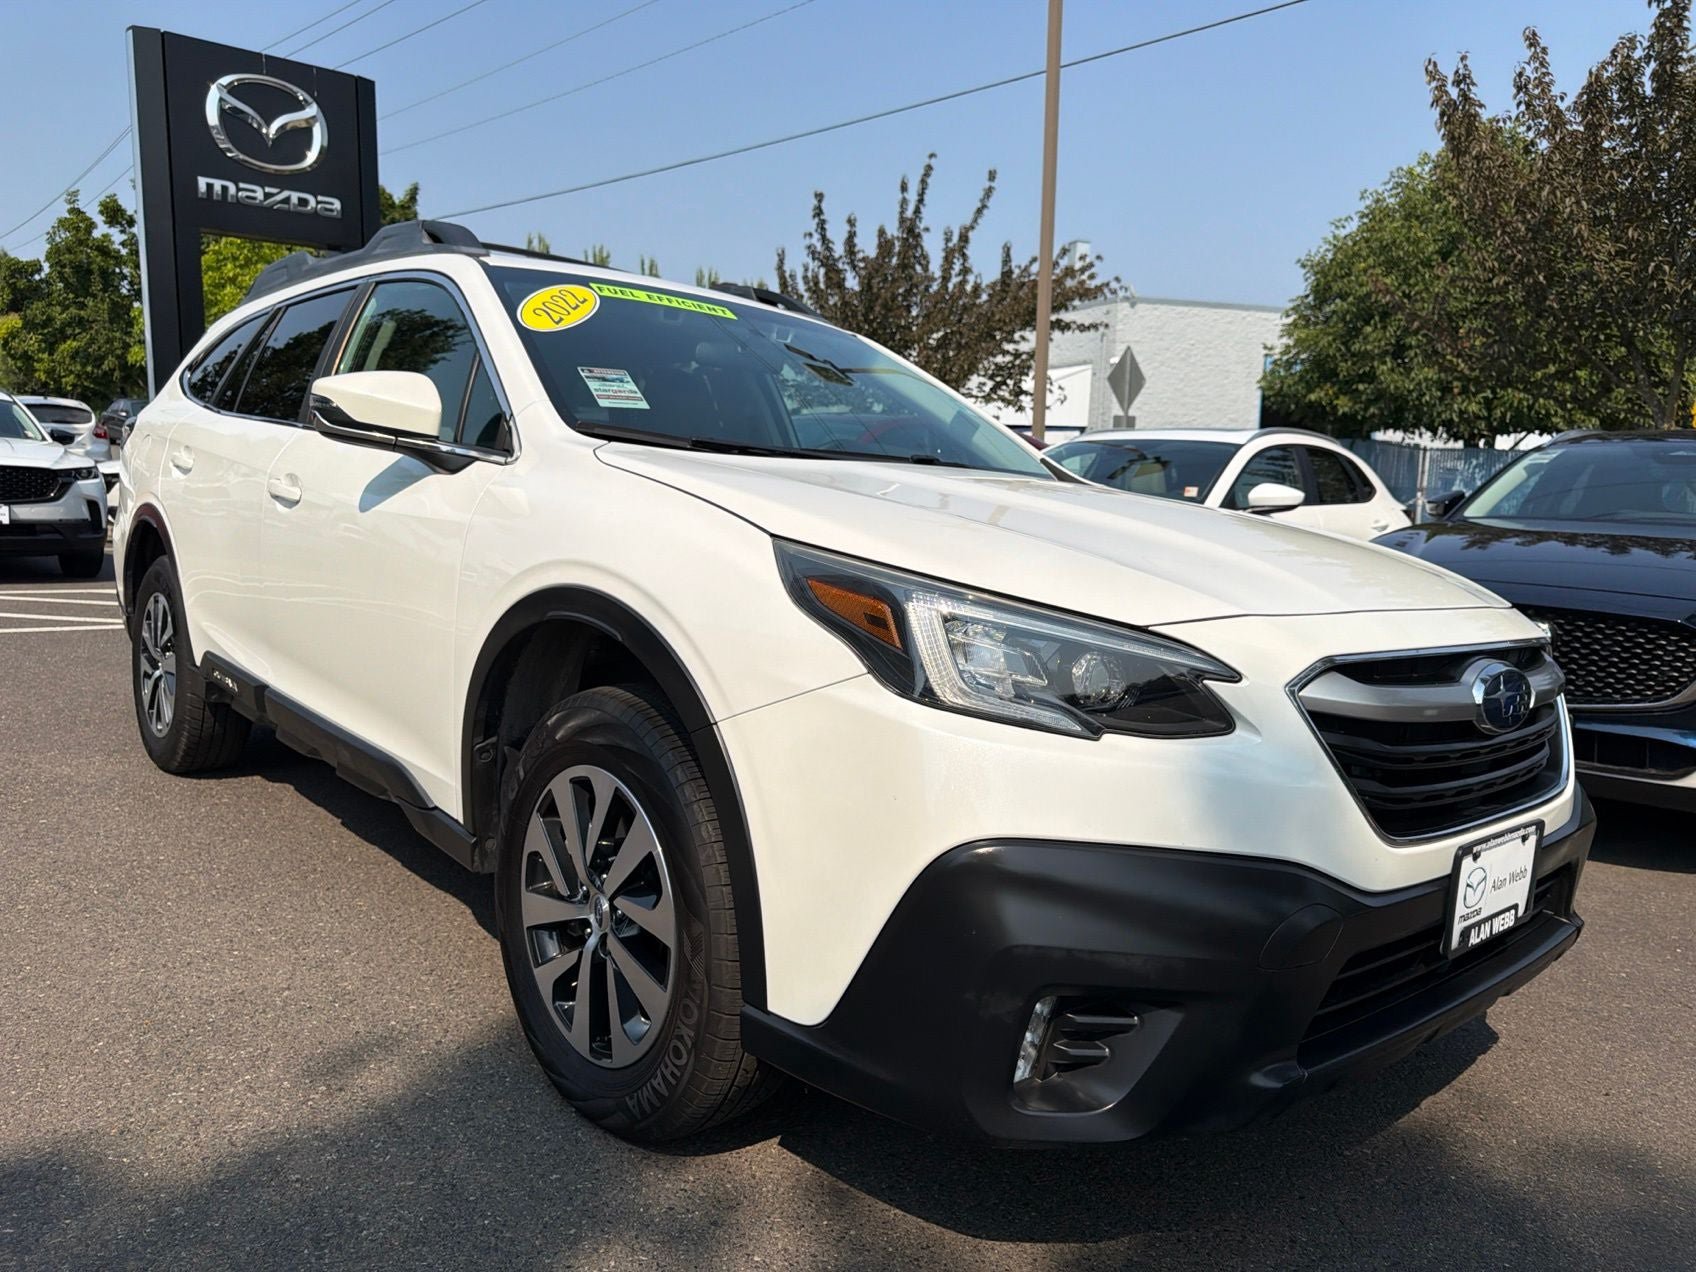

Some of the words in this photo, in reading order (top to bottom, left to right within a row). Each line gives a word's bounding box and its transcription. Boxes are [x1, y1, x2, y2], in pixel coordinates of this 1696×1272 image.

[533, 288, 588, 326] 2022
[595, 286, 640, 299] FUEL
[646, 293, 729, 316] EFFICIENT
[1490, 877, 1507, 894] Alan
[1509, 865, 1528, 886] Webb
[1468, 919, 1491, 947] ALAN
[1492, 909, 1515, 935] WEBB
